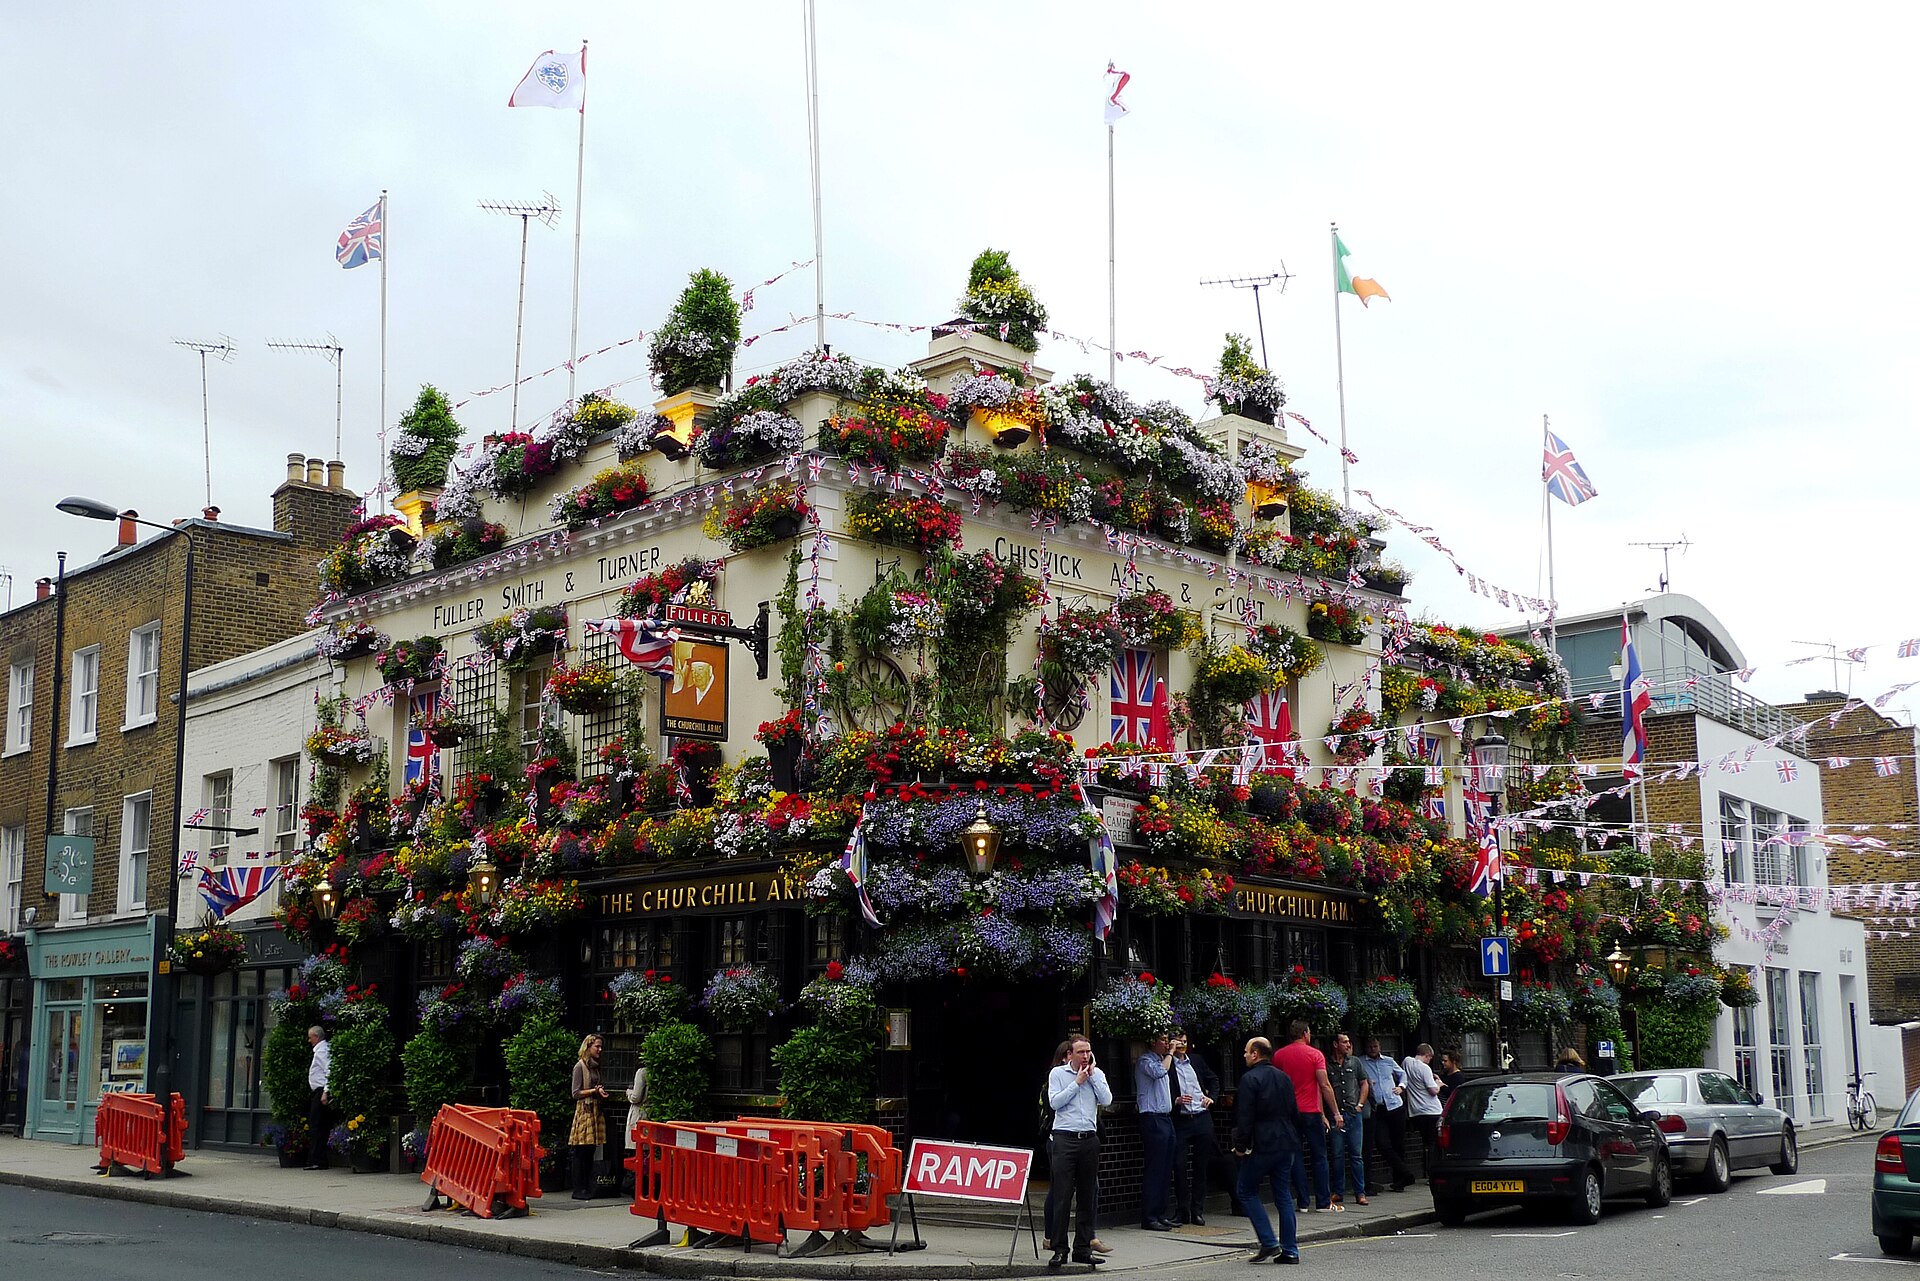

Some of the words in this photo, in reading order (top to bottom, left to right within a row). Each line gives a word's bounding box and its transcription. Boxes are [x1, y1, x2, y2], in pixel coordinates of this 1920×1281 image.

[433, 598, 484, 630] FULLER
[502, 580, 544, 610] SMITH
[565, 571, 575, 593] &
[1181, 583, 1192, 604] &
[1215, 587, 1265, 620] STOT
[669, 606, 727, 627] FULLER'S
[666, 719, 677, 729] THE
[678, 720, 706, 732] CHURCHILL
[707, 724, 722, 734] ARMS
[1106, 816, 1131, 830] CAMPD
[1108, 829, 1130, 842] TREET
[600, 892, 633, 915] THE
[642, 881, 757, 912] CHURCHILL
[766, 879, 809, 901] AR
[1236, 890, 1317, 919] CHURCHILL
[1321, 900, 1354, 921] ARM
[44, 955, 59, 969] THE
[61, 951, 92, 968] ROWLEY
[95, 948, 132, 966] GALLERY
[1600, 1041, 1607, 1050] P
[916, 1151, 1018, 1190] RAMP
[1475, 1181, 1499, 1192] EG04
[1501, 1181, 1520, 1191] YYL
